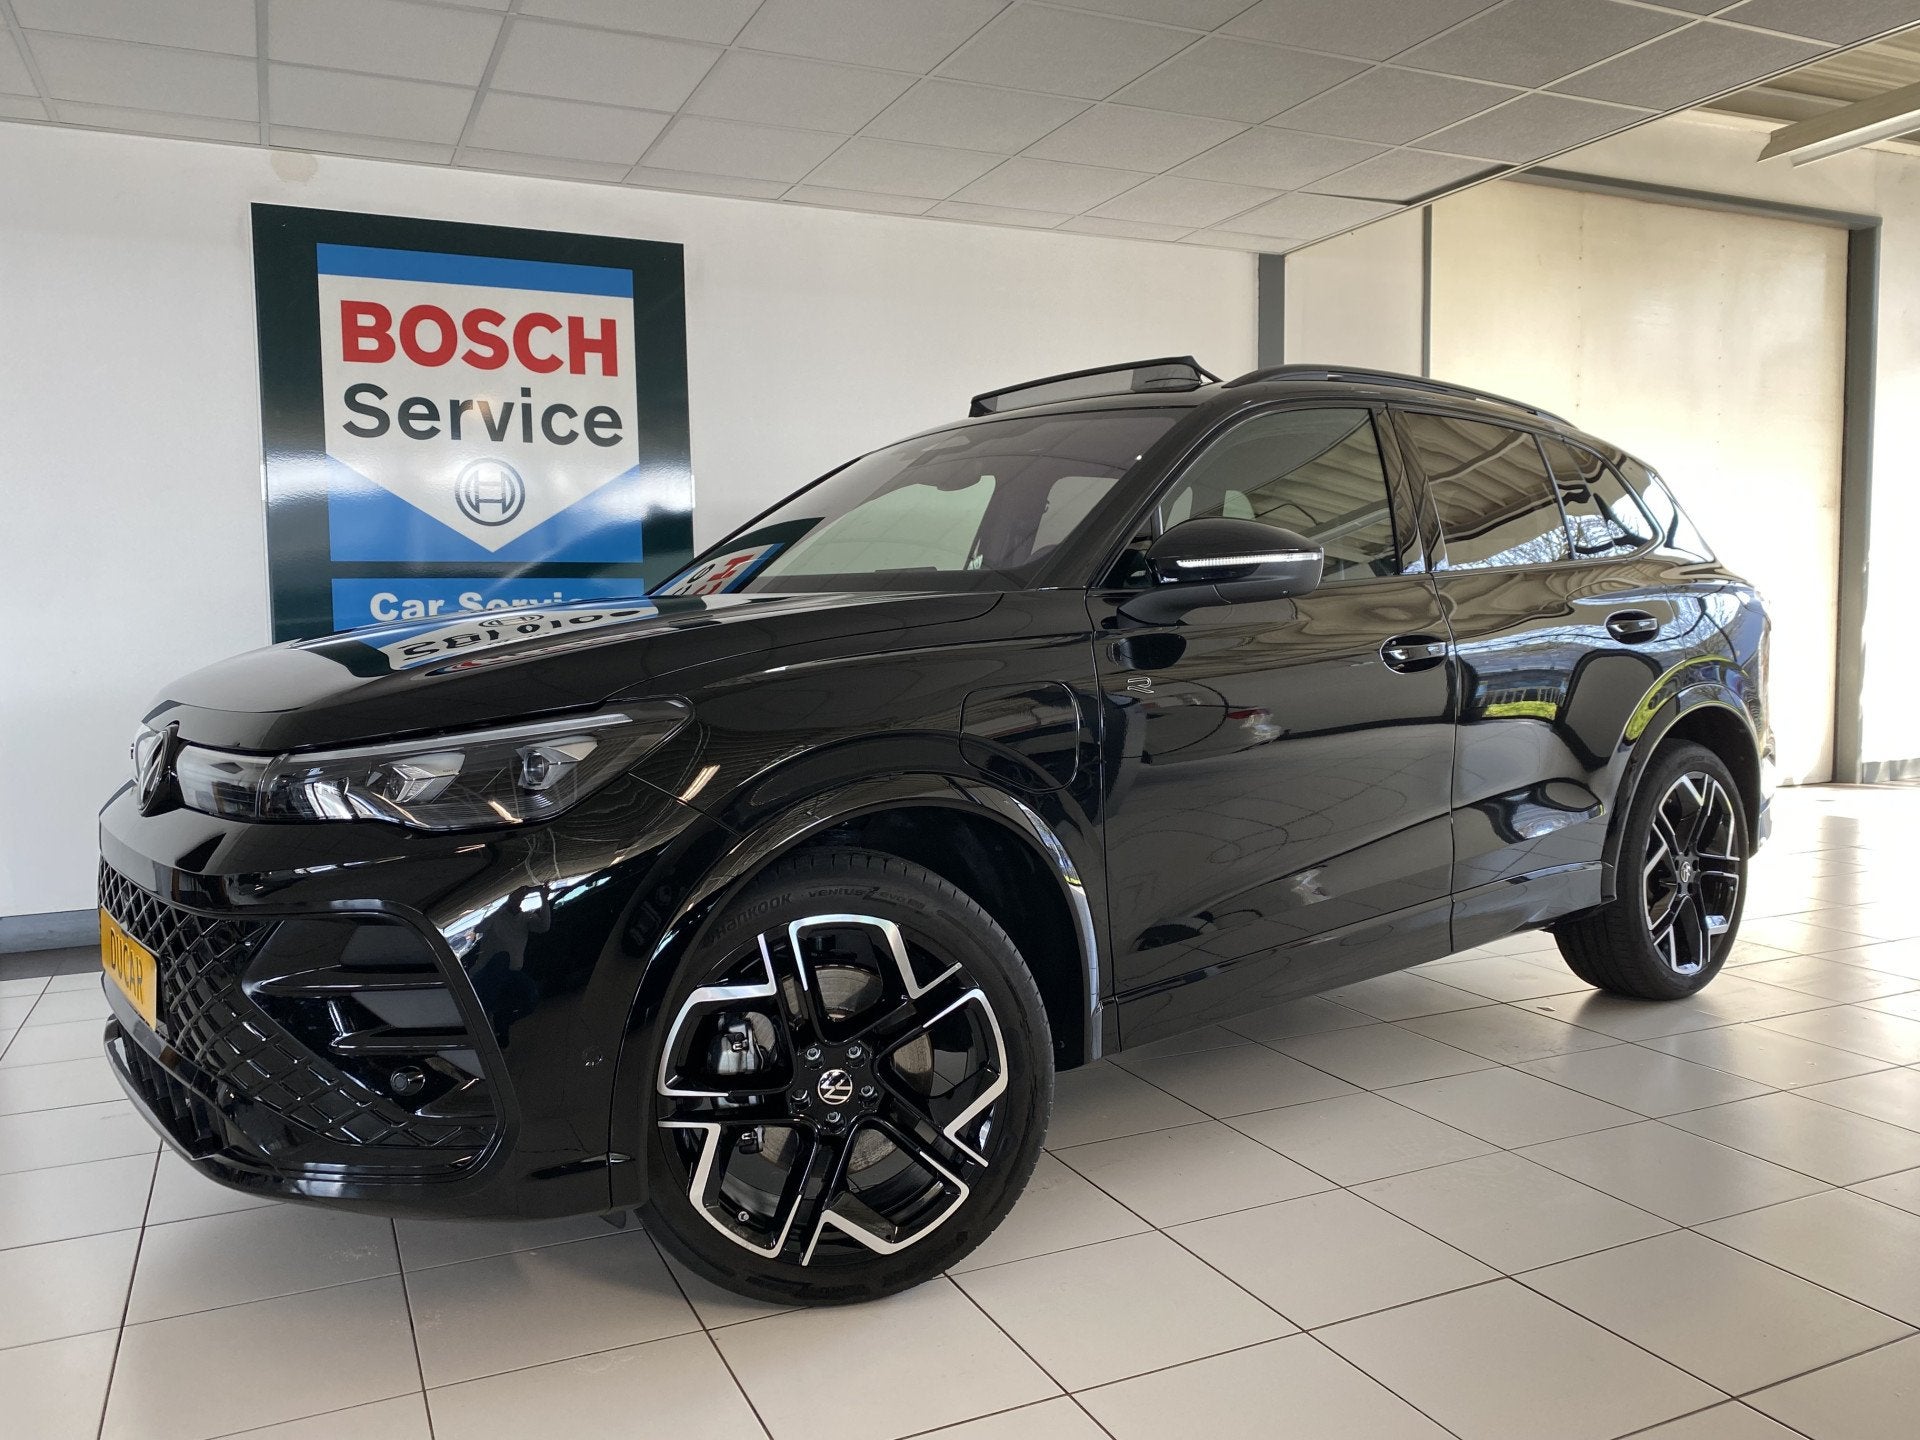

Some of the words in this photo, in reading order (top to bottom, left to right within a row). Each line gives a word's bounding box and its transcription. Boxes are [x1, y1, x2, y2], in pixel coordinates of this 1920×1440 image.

[340, 300, 618, 377] BOSCH
[342, 382, 623, 447] Service
[370, 592, 445, 621] Car
[110, 927, 144, 1005] DUCAR
